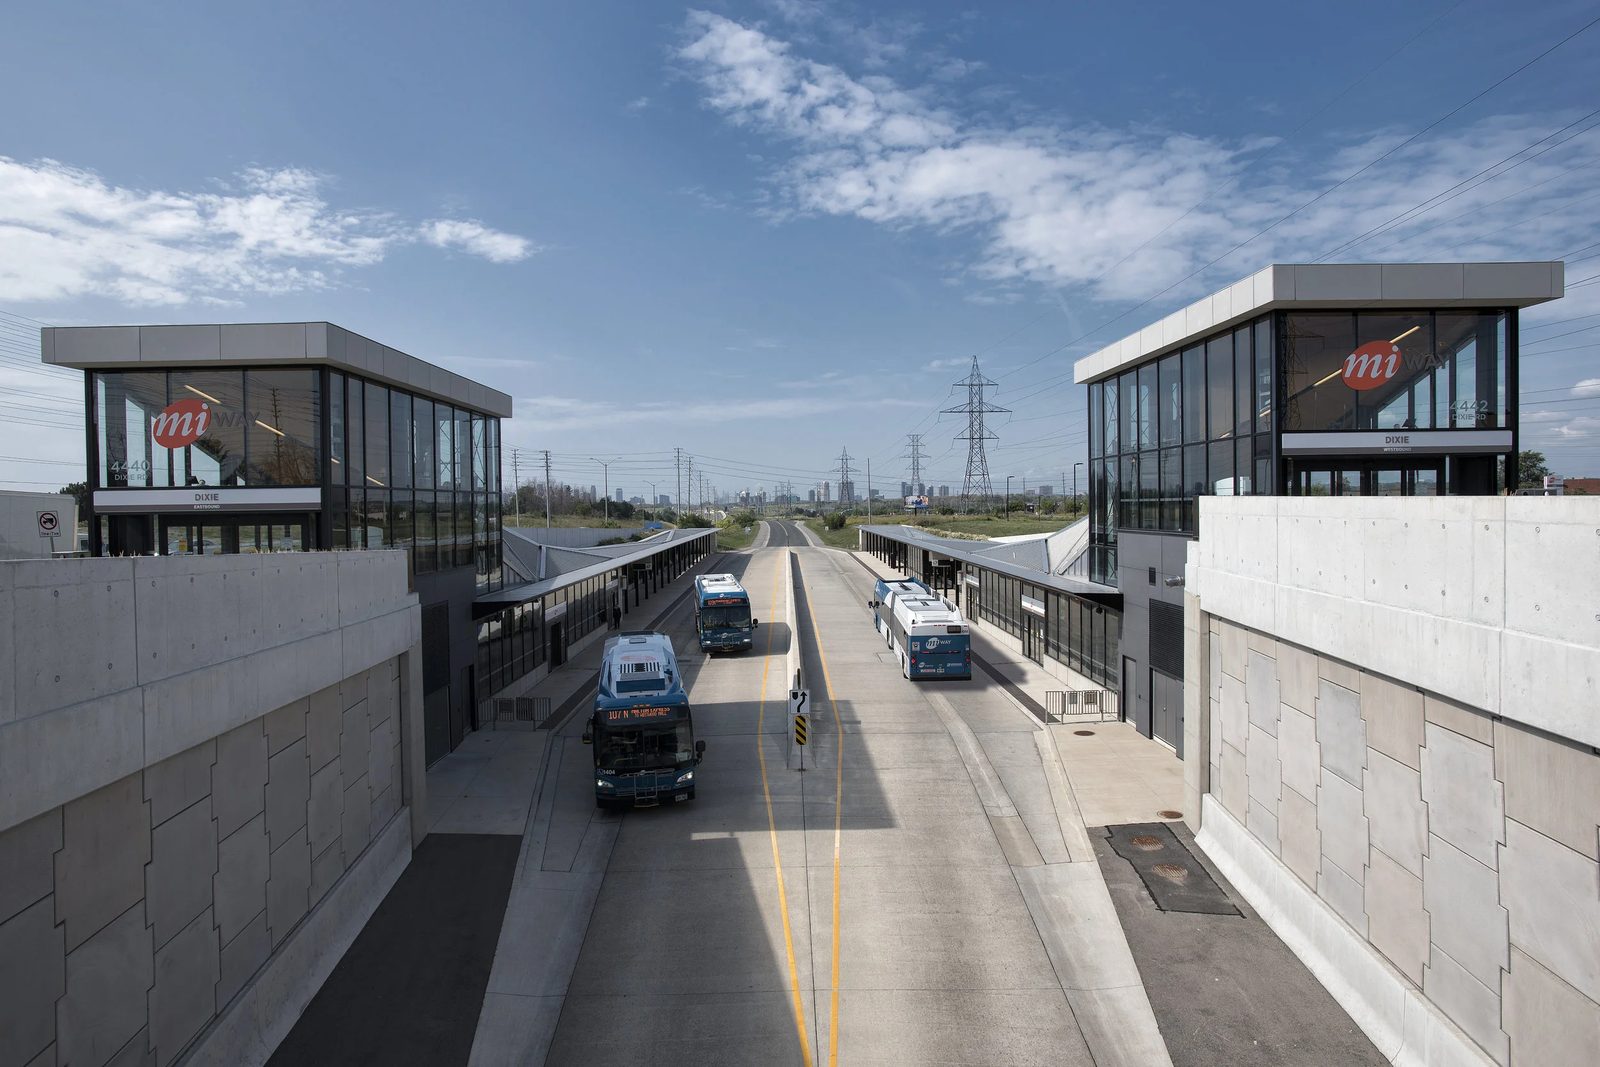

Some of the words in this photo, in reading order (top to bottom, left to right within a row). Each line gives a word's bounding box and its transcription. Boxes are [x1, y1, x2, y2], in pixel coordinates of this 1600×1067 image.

[1404, 352, 1446, 370] WAY
[1450, 400, 1488, 412] 4442
[214, 412, 260, 427] WAY
[1385, 436, 1409, 444] DIXIE
[111, 460, 150, 472] 4440
[194, 493, 219, 501] DIXIE
[608, 710, 621, 720] 107
[623, 709, 629, 719] N
